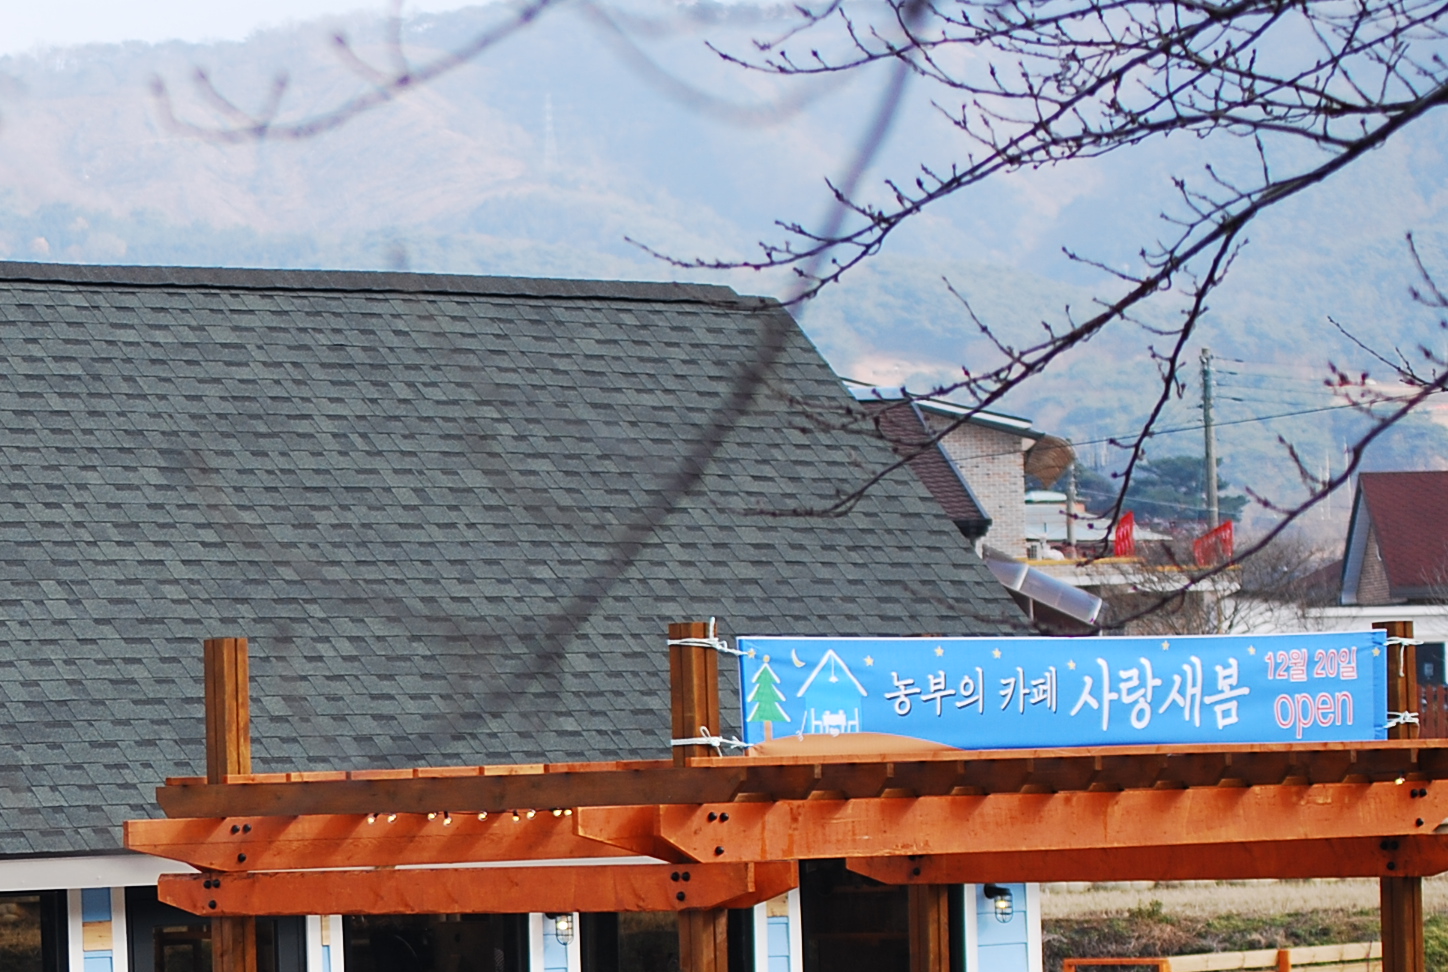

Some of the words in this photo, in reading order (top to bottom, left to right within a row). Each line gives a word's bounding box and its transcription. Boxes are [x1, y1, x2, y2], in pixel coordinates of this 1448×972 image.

[1265, 648, 1308, 682] 12월
[1314, 646, 1358, 680] 20일
[884, 670, 985, 717] 농부의
[999, 666, 1058, 715] 카페
[1070, 655, 1250, 731] 사랑새봄
[1274, 691, 1354, 739] open
